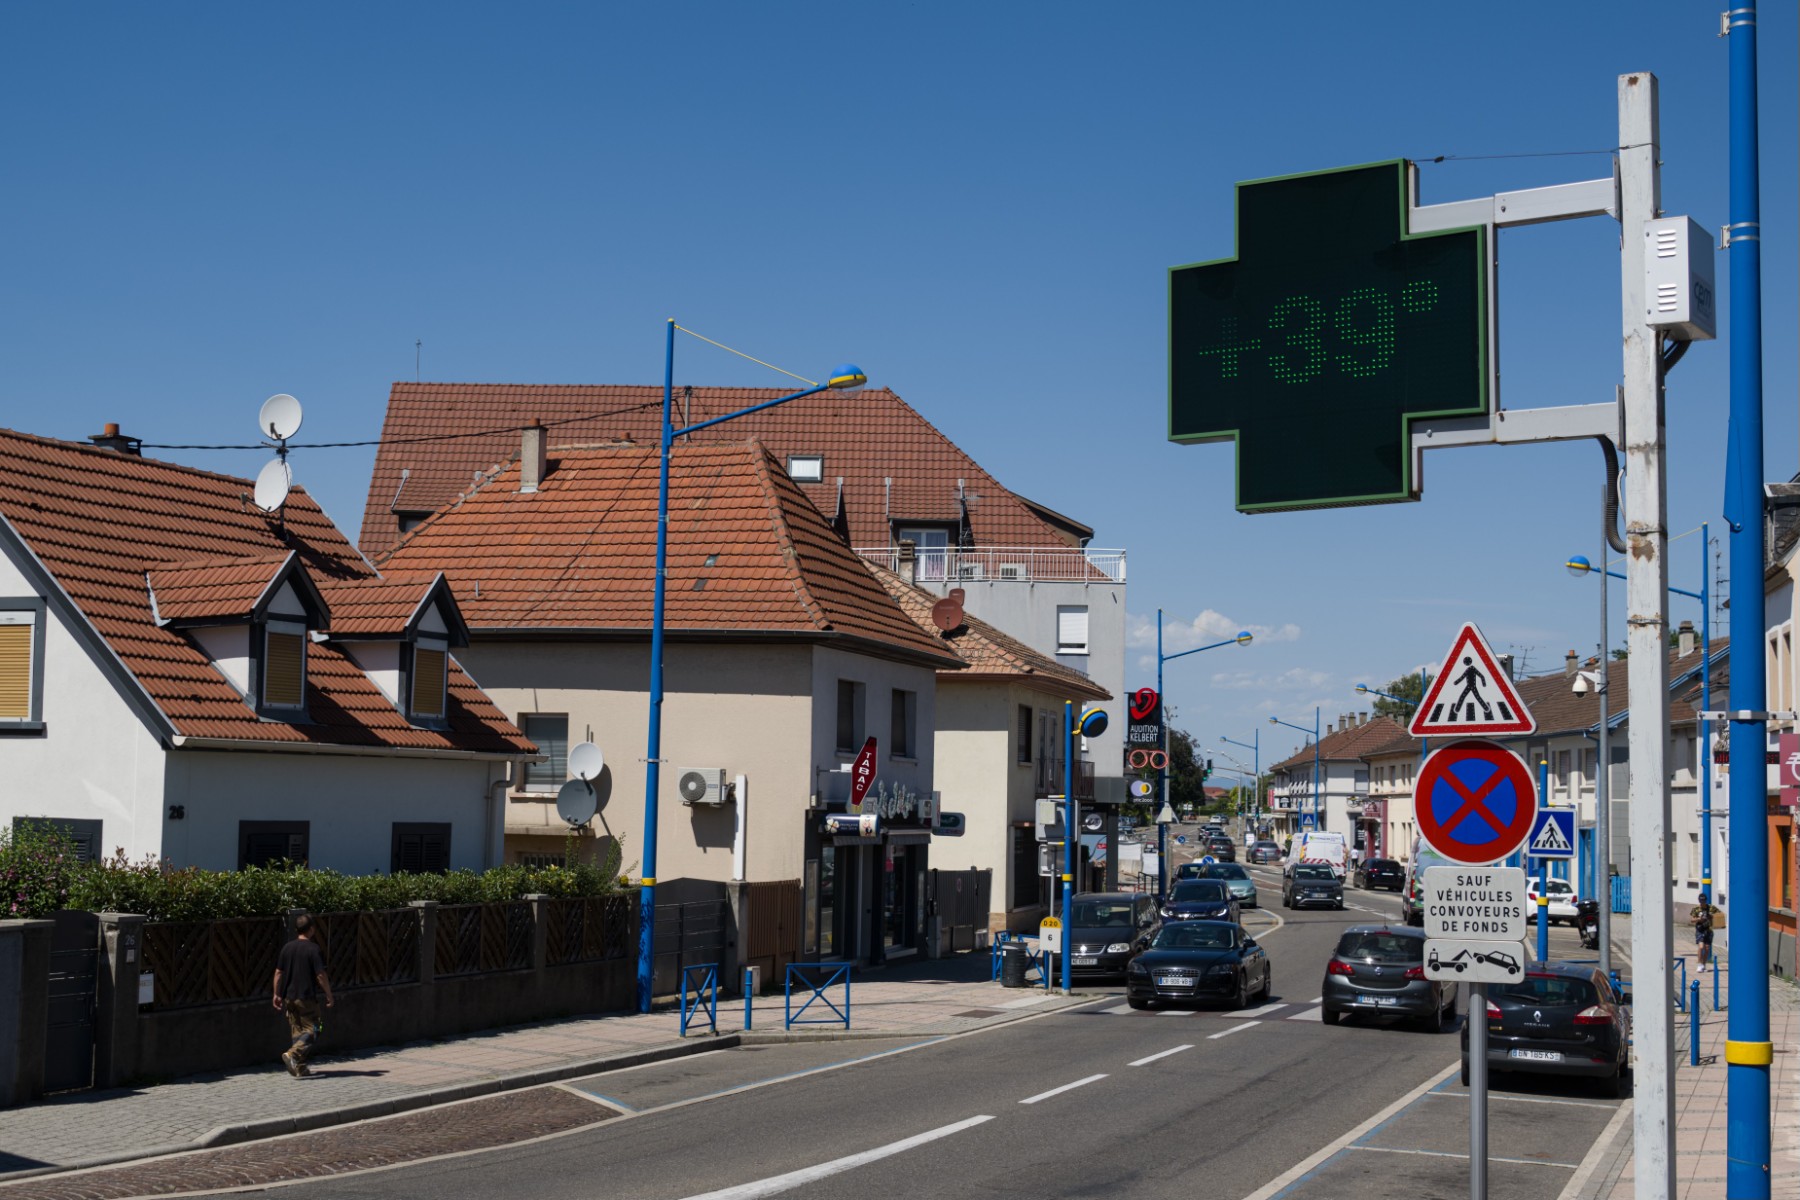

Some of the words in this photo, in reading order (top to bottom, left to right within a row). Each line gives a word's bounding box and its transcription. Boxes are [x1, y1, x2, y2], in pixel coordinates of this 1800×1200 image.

[1130, 724, 1159, 733] AUDITION
[1130, 732, 1158, 742] KELBERT
[856, 751, 872, 791] TABAC
[168, 805, 185, 820] 26
[1457, 875, 1492, 886] SAUF
[1437, 888, 1513, 902] VÉHICULES
[1430, 905, 1520, 918] CONVOYEURS
[1442, 921, 1458, 932] DE
[1464, 921, 1508, 933] FONDS
[1047, 933, 1053, 941] 6
